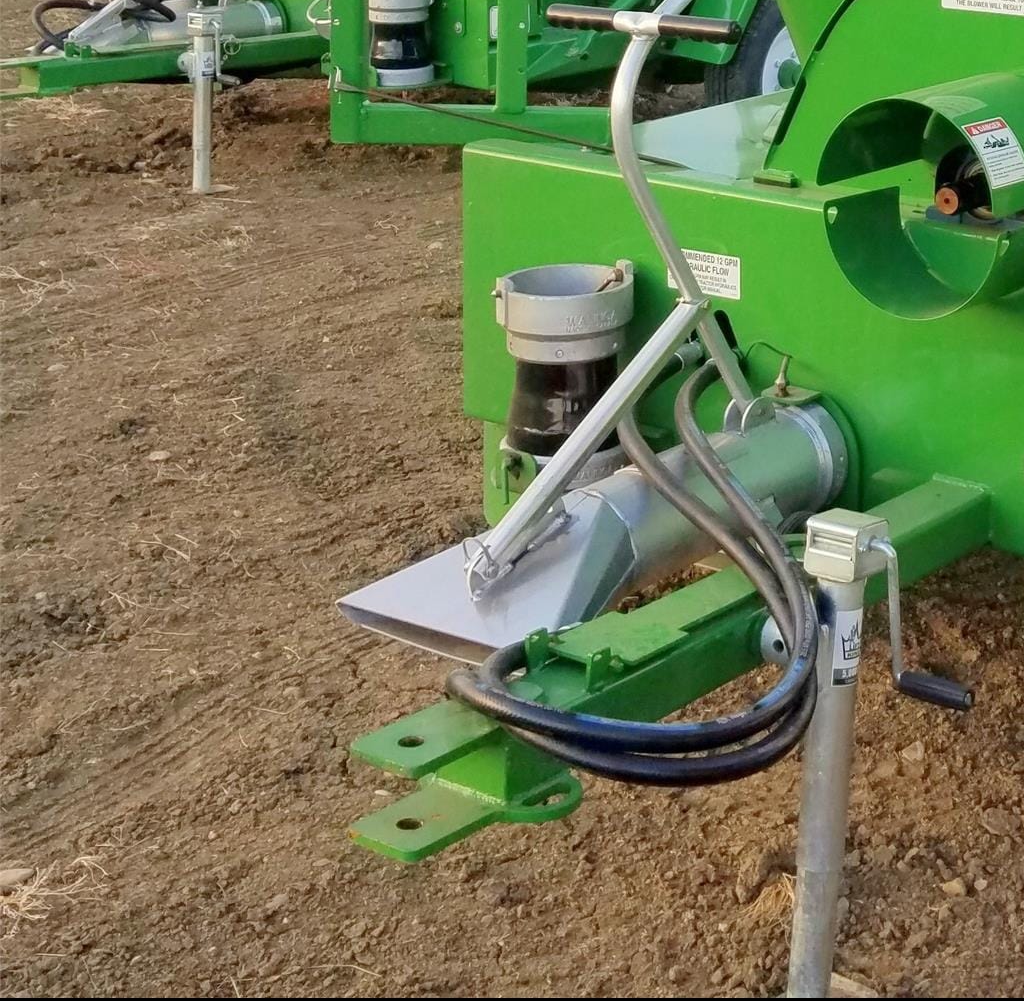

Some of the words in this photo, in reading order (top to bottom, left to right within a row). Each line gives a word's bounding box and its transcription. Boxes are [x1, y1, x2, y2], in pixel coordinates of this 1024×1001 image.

[989, 2, 1001, 10] WILL
[1003, 3, 1022, 11] RESULT
[724, 258, 738, 267] GPM
[689, 262, 711, 273] RAULIC
[712, 266, 729, 276] FLOW
